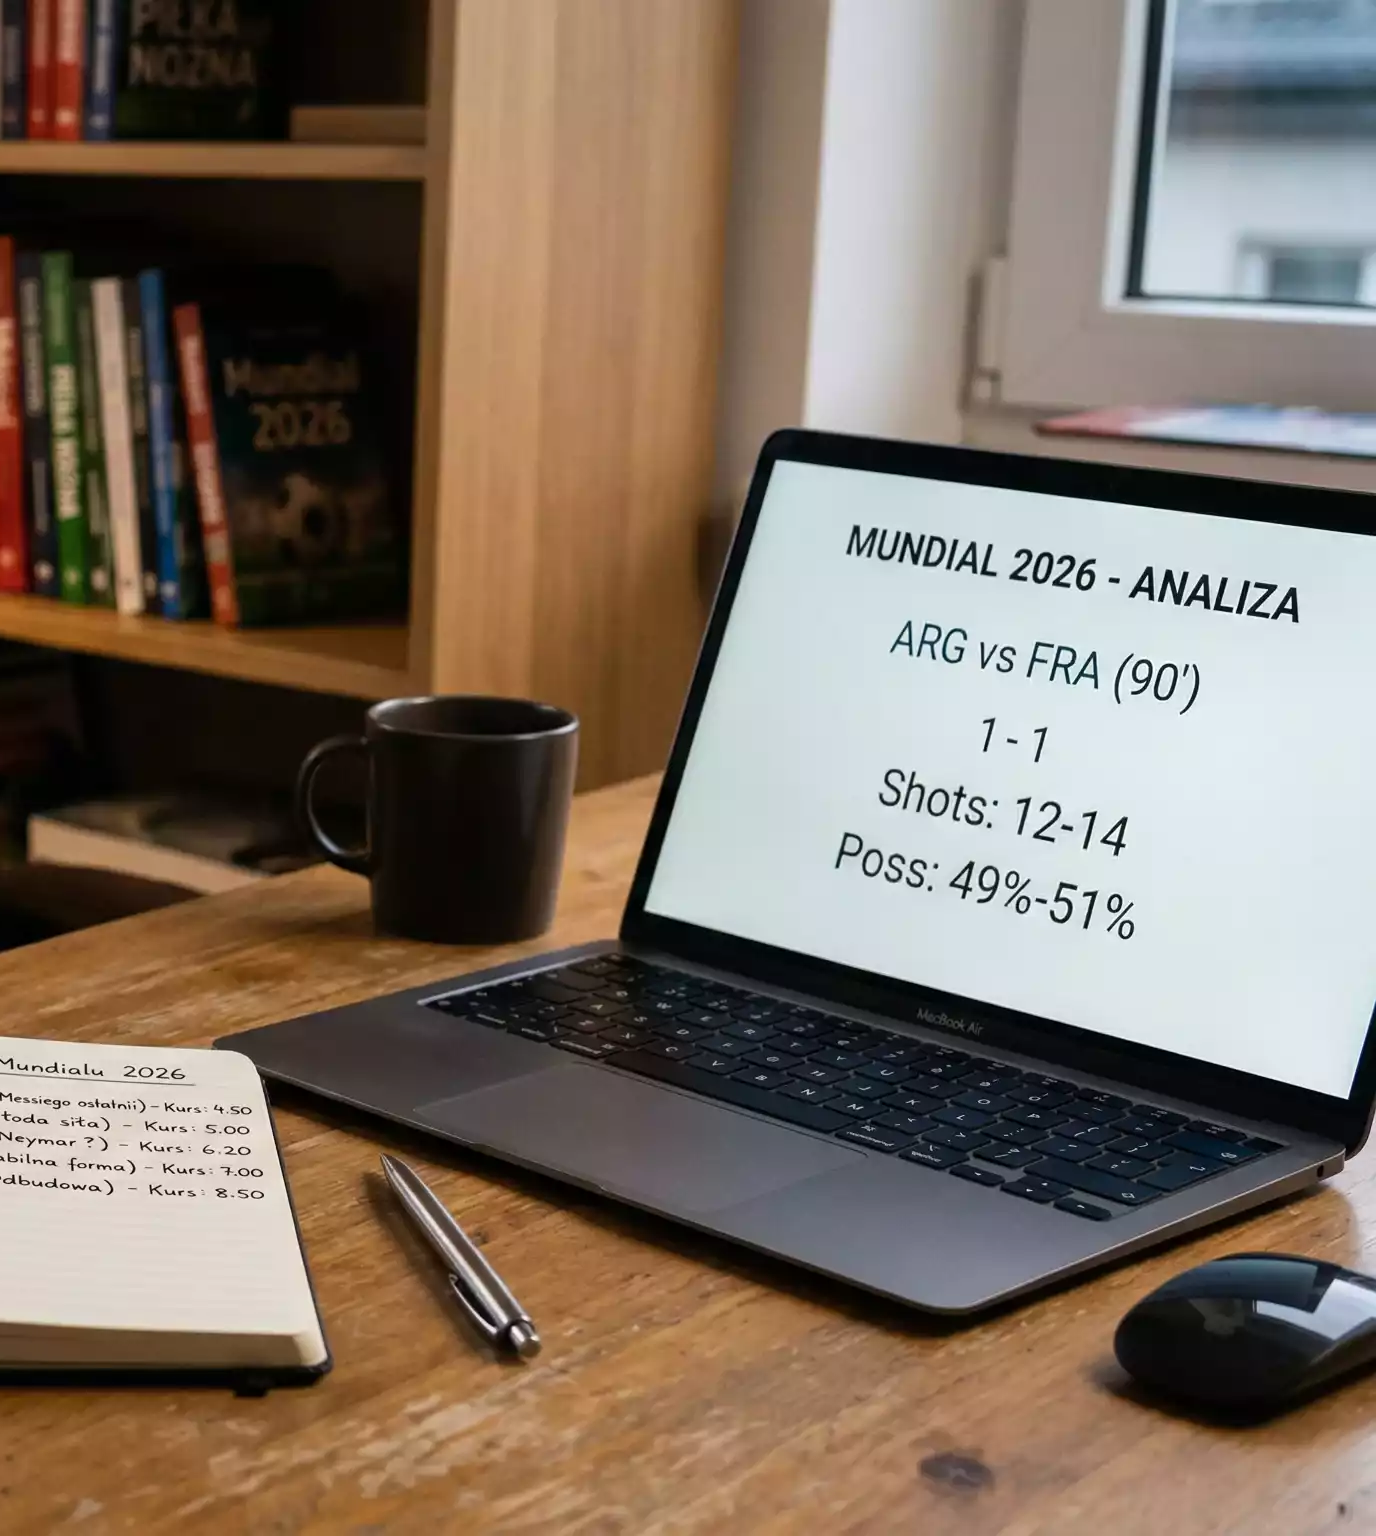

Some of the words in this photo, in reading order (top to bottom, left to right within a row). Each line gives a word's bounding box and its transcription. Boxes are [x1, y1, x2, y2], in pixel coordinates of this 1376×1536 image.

[249, 401, 352, 450] 2026
[845, 523, 998, 578] MUNDIAL
[1008, 547, 1097, 592] 2026
[1127, 565, 1300, 624] ANALIZA
[889, 619, 968, 665] ARG
[979, 641, 1017, 674] vs
[1025, 640, 1099, 690] FRA
[1113, 652, 1201, 716] (90')
[982, 716, 997, 753] 1
[1033, 726, 1049, 764] 1
[878, 768, 999, 830] Shots:
[1016, 795, 1129, 857] 12-14
[834, 831, 940, 893] Poss:
[948, 859, 1135, 941] 49%-51%
[916, 1007, 965, 1032] MacBook
[966, 1021, 984, 1037] Air
[123, 1065, 187, 1080] 2026
[163, 1101, 208, 1114] Kurs:
[213, 1104, 253, 1116] 4.50
[144, 1120, 196, 1134] Kurs:
[204, 1123, 251, 1136] 5.00
[139, 1140, 192, 1154] Kurs:
[202, 1144, 252, 1156] 6.20
[66, 1156, 137, 1176] forma)
[162, 1162, 214, 1176] Kurs:
[219, 1166, 264, 1178] 7.00
[148, 1183, 206, 1198] Kurs:
[214, 1187, 265, 1200] 8.50
